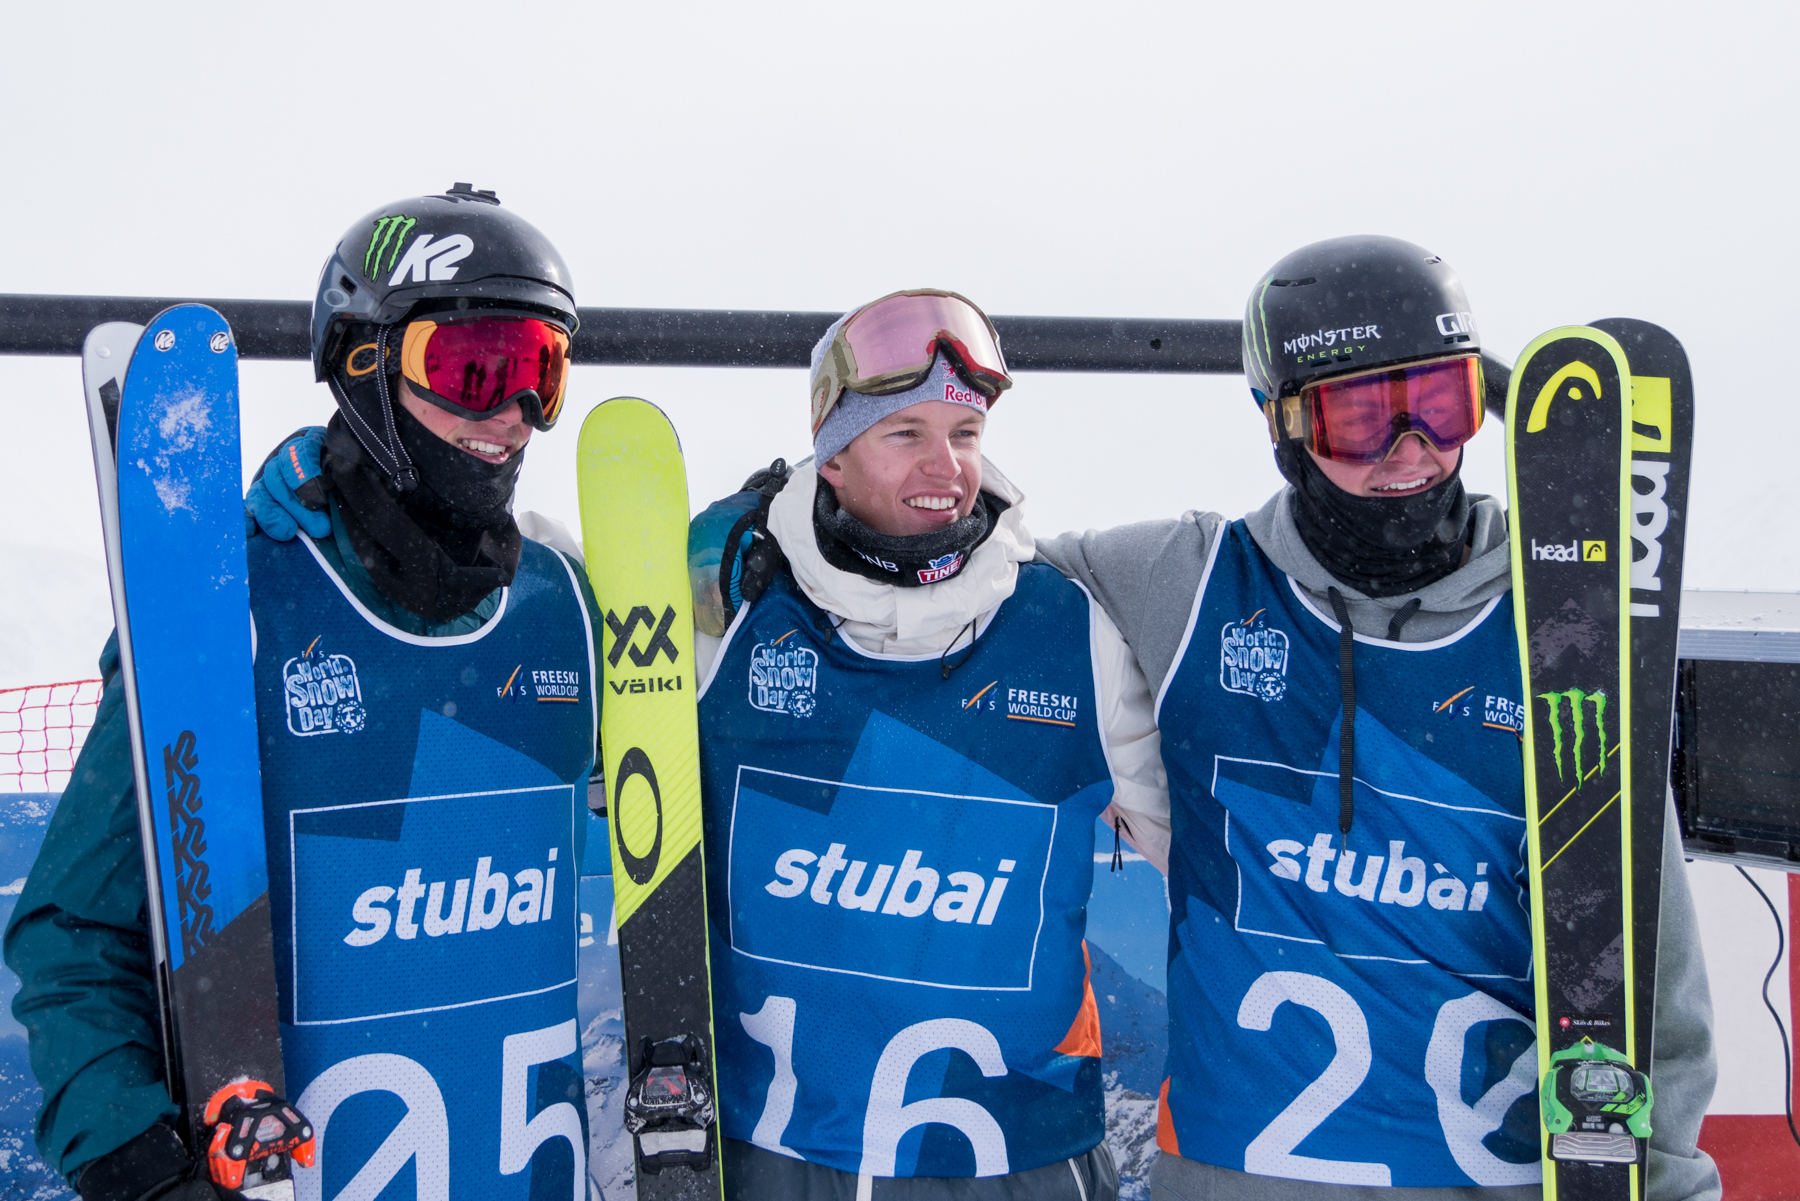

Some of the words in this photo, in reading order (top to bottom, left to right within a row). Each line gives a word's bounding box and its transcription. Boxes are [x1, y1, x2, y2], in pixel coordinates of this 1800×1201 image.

[388, 233, 475, 287] K2
[1296, 344, 1366, 363] ENERGY
[945, 384, 972, 403] Red
[1531, 538, 1579, 562] head
[924, 560, 959, 581] TINE
[1231, 627, 1278, 647] World
[761, 648, 807, 667] World
[296, 658, 344, 683] World
[531, 670, 579, 685] FREESKI
[1229, 666, 1257, 692] Day
[535, 684, 566, 696] WORLD
[566, 685, 579, 697] CUP
[757, 685, 789, 710] Day
[1008, 688, 1078, 710] FREESKI
[298, 706, 334, 732] Day
[1008, 702, 1053, 718] WORLD
[1054, 708, 1077, 721] CUP
[1484, 695, 1525, 720] FREE
[764, 842, 1017, 926] stubai
[1266, 832, 1489, 912] stubai
[343, 847, 559, 948] stubai
[739, 995, 1010, 1178] 16
